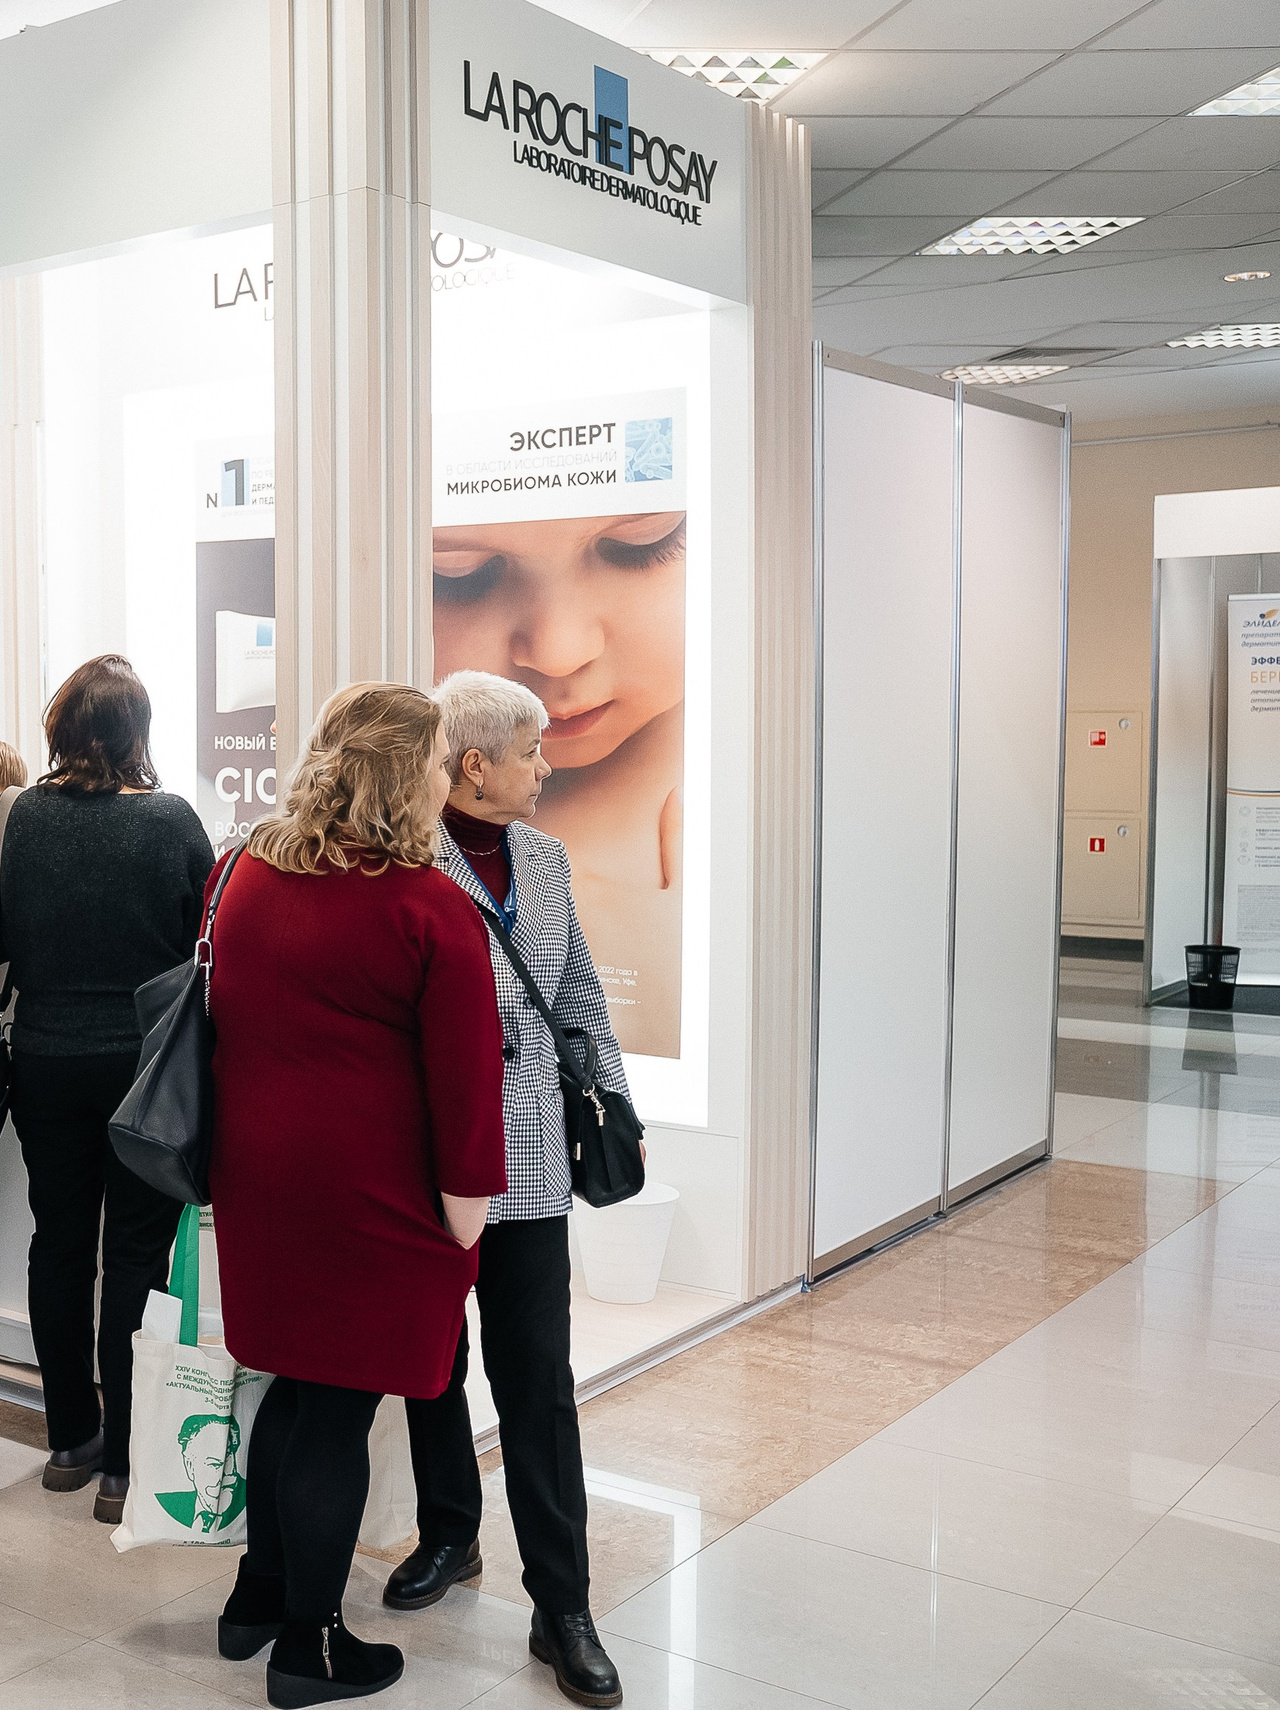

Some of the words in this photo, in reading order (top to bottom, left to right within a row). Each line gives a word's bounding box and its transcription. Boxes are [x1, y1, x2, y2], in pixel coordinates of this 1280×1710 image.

[463, 59, 510, 130] LA
[513, 79, 624, 172] ROCHE
[628, 125, 718, 204] POSAY
[509, 422, 617, 452] ЭКСПЕРТ
[457, 460, 512, 475] ОБЛАСТИ
[514, 449, 617, 470] ИССЛЕДОВАНИЙ
[446, 474, 563, 496] МИКРОБИОМА
[567, 469, 617, 487] КОЖИ
[206, 492, 218, 509] N
[259, 496, 274, 505] ПЕД
[214, 733, 266, 751] НОВЫЙ
